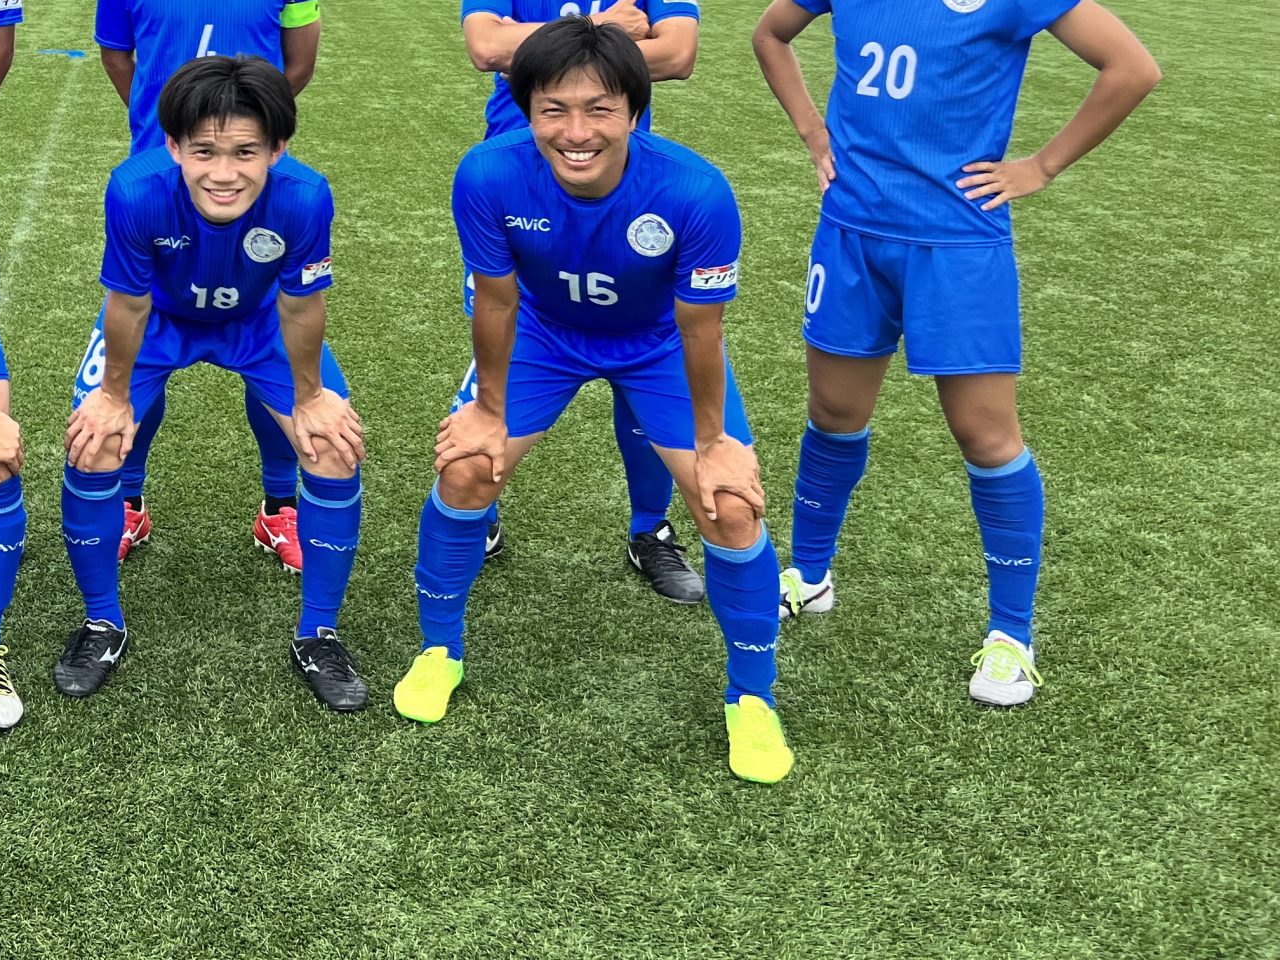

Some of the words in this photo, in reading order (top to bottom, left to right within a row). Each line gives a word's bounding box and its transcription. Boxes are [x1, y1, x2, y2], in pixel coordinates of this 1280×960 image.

[856, 41, 918, 100] 20
[190, 282, 240, 310] 18
[558, 270, 619, 306] 15
